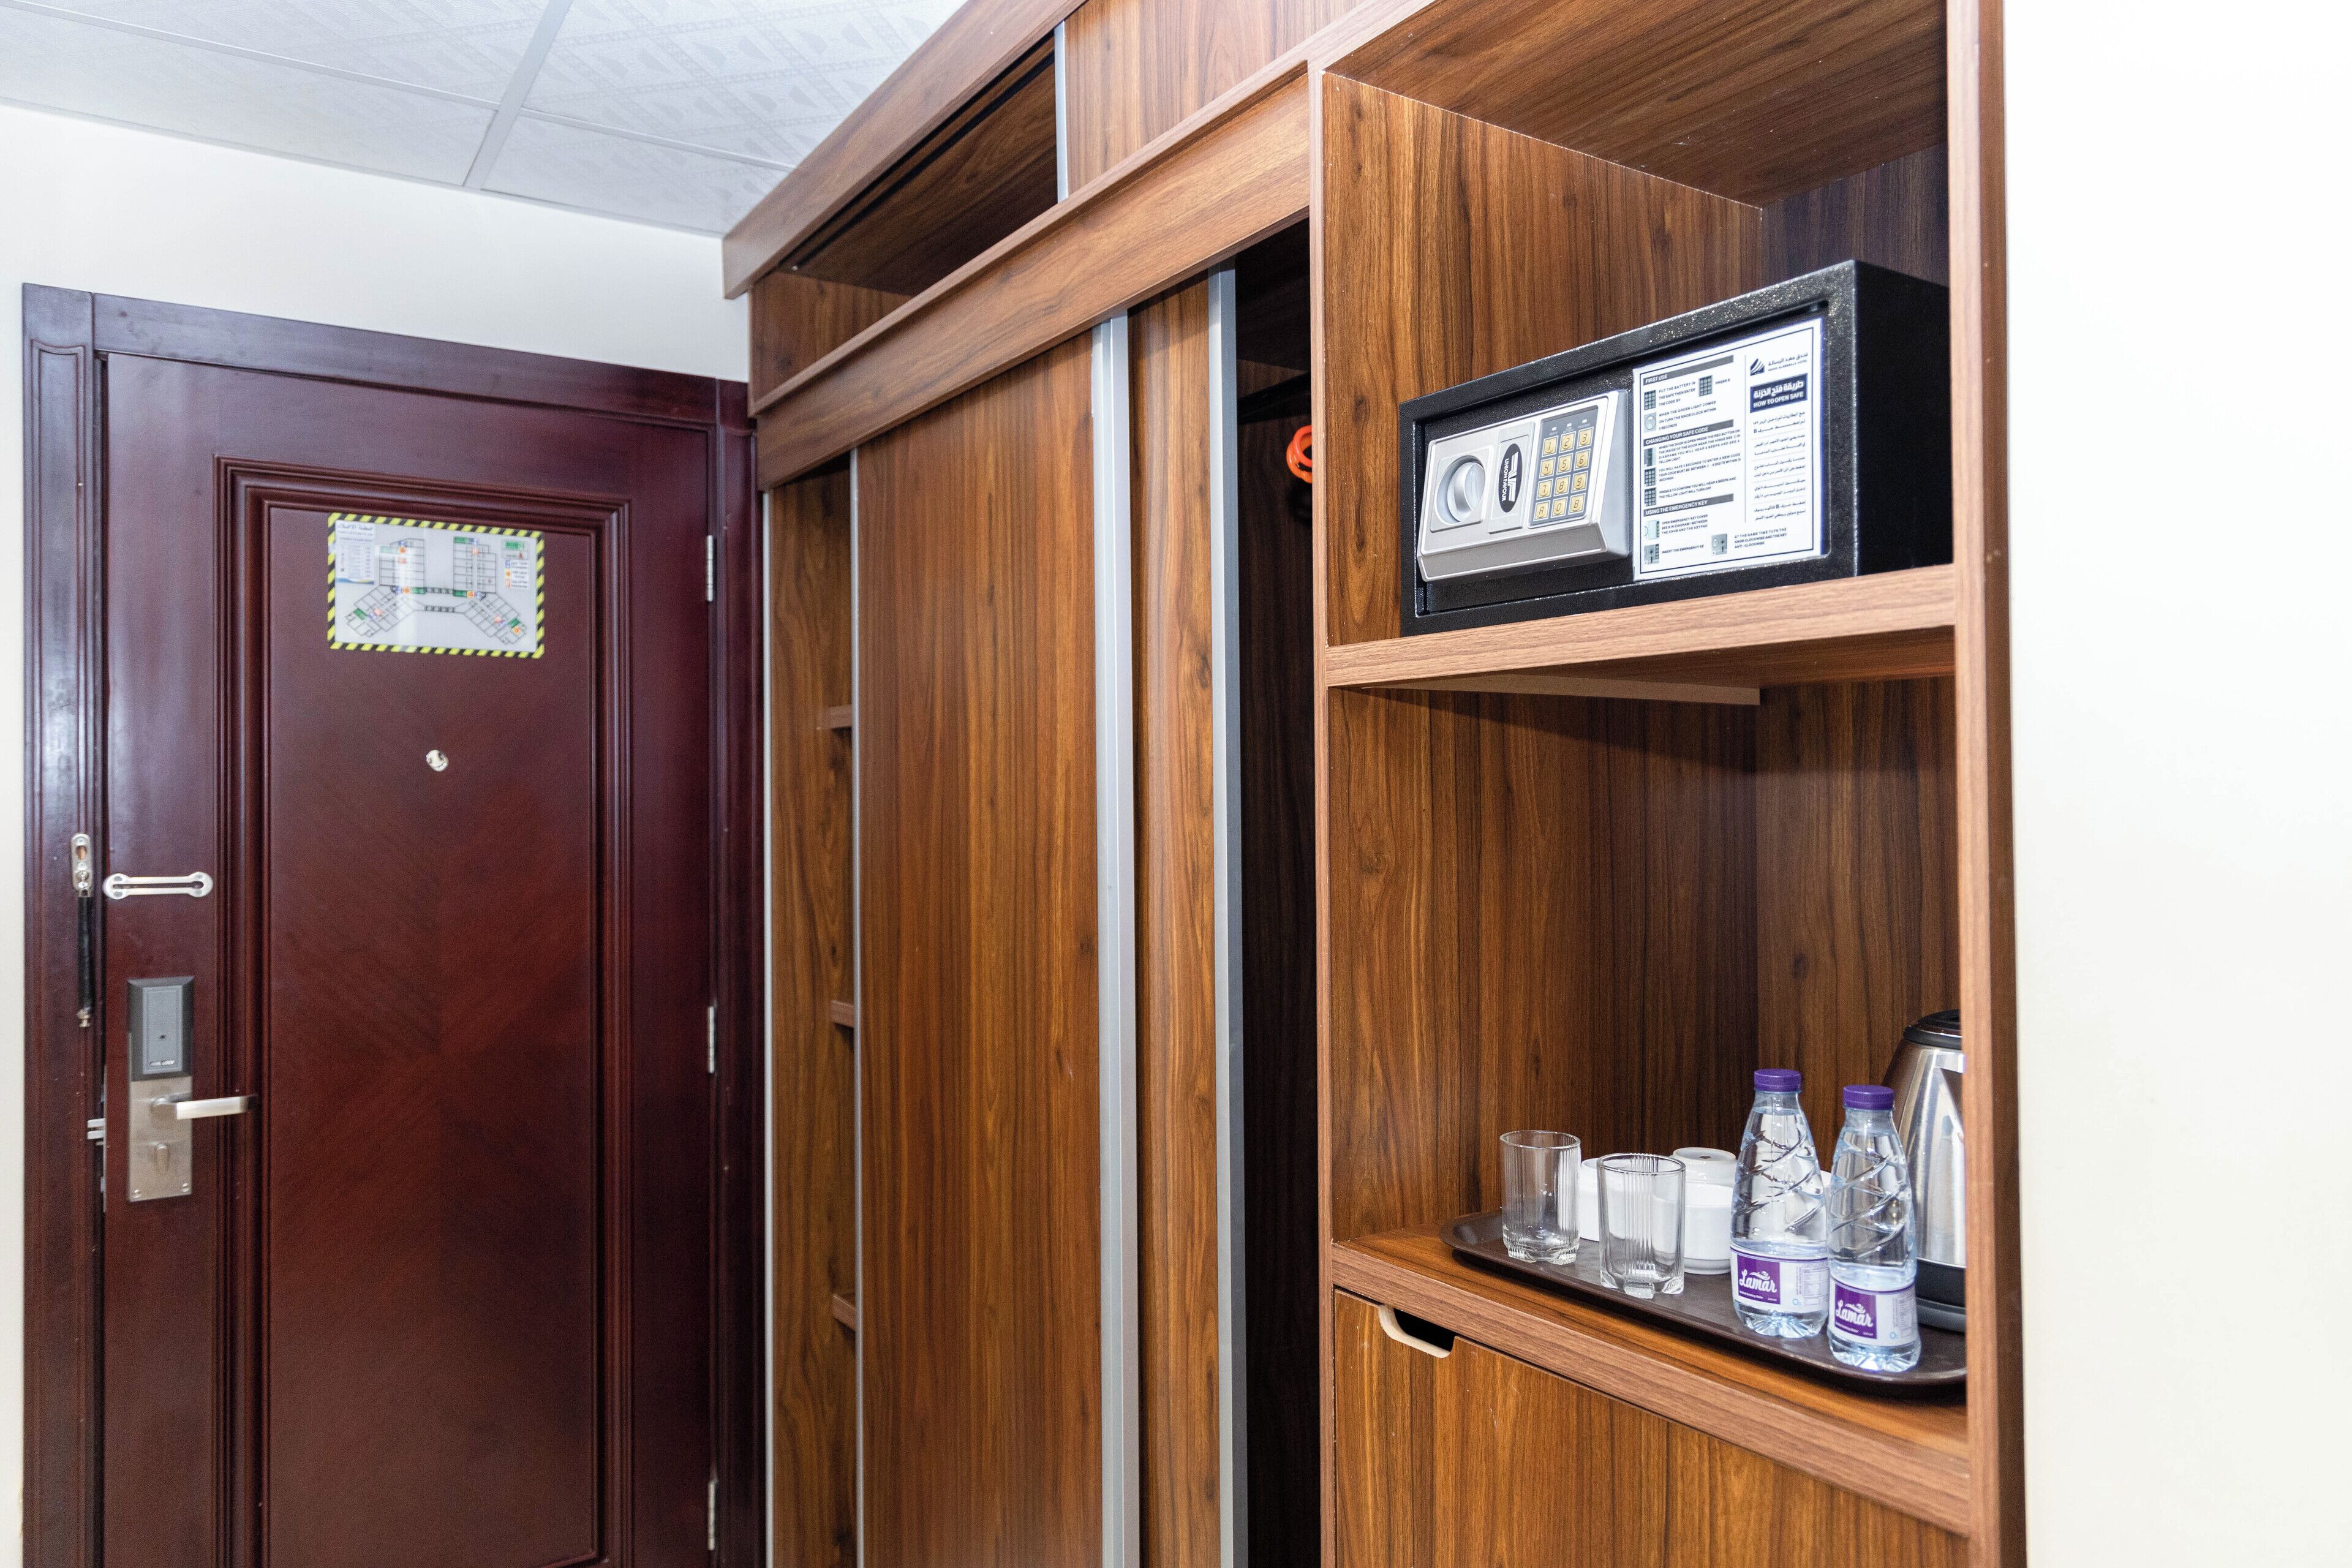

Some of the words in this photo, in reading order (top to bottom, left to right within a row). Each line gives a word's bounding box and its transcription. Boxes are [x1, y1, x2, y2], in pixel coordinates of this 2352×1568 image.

[1645, 375, 1658, 384] FIRST
[1783, 379, 1803, 393] طريقة
[1753, 386, 1771, 400] الخزنة
[1771, 383, 1782, 397] فتح
[1753, 399, 1766, 408] HOW
[1774, 394, 1789, 403] OPEN
[1789, 391, 1803, 400] SAFE
[1564, 438, 1570, 447] 2
[1582, 434, 1588, 442] 3
[1646, 434, 1669, 445] CHANGING
[1669, 431, 1683, 440] YOUR
[1695, 426, 1708, 434] CODE
[1562, 459, 1567, 468] 5
[1579, 455, 1585, 464] 6
[1559, 481, 1564, 490] 8
[1577, 477, 1581, 486] 9
[1556, 503, 1561, 511] 0
[1669, 501, 1697, 511] EMERGENCY
